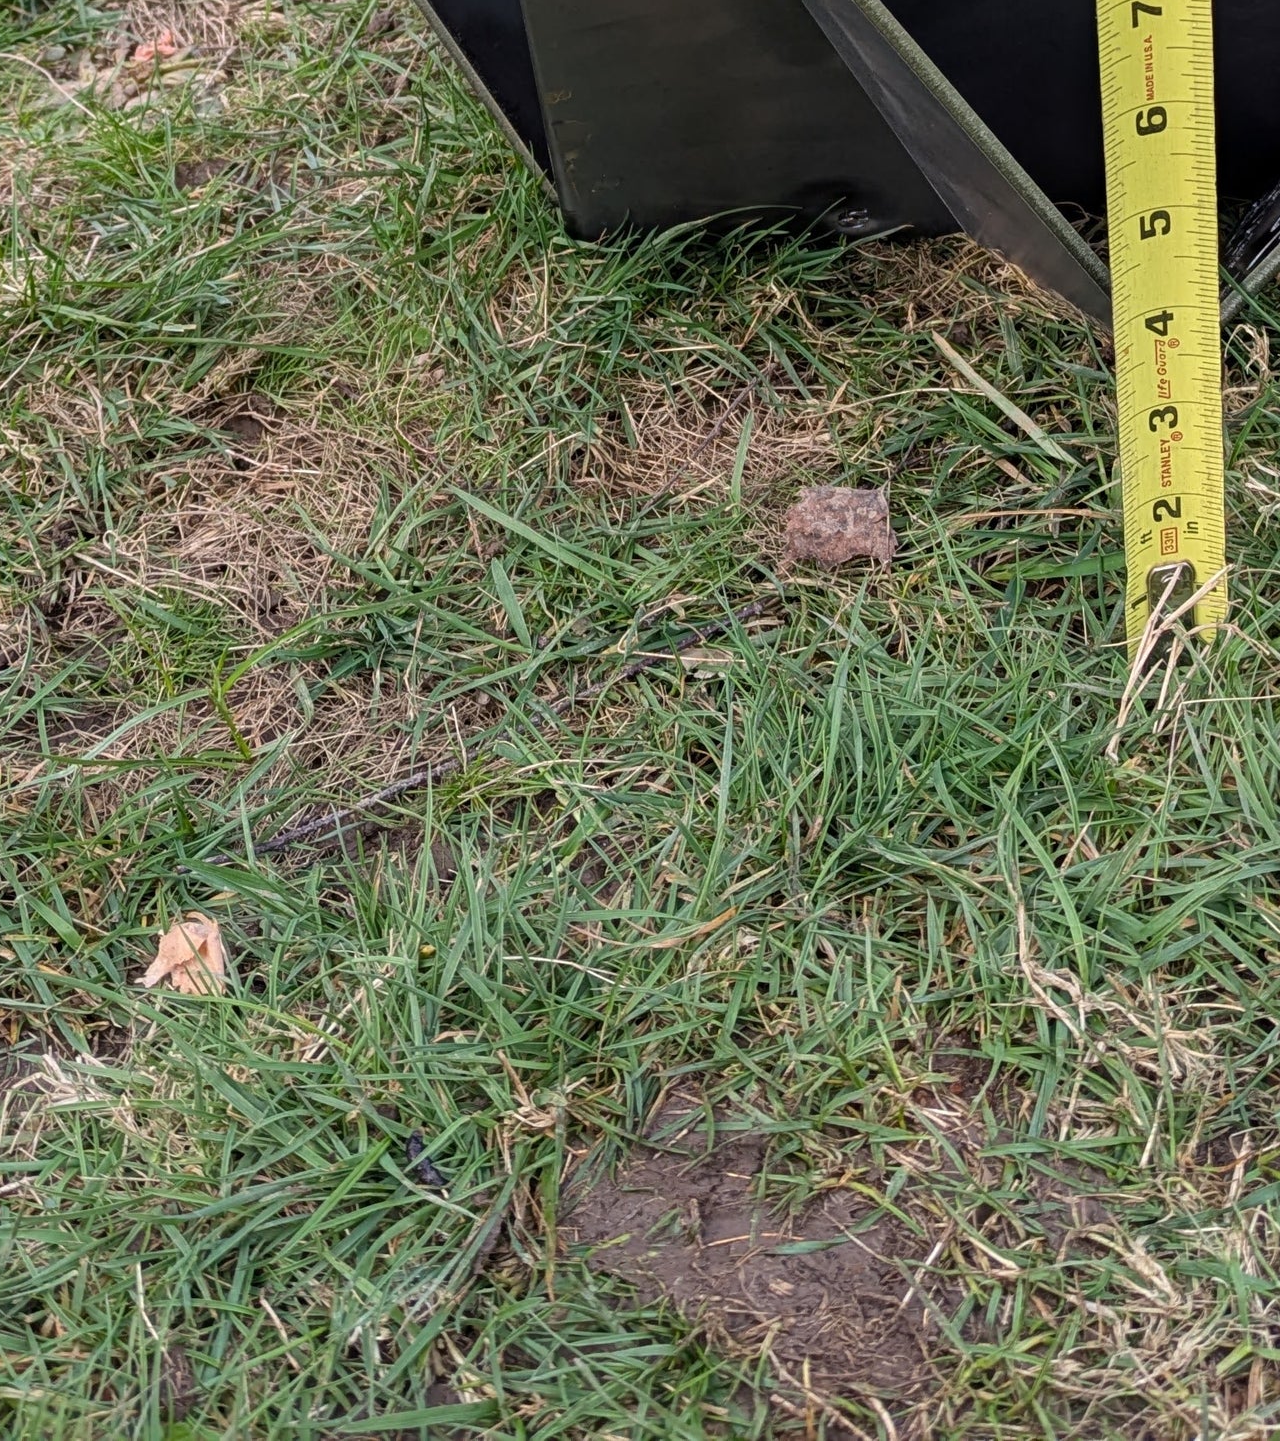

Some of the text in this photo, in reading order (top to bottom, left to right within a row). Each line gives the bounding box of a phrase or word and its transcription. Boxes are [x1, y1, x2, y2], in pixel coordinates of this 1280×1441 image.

[1131, 1, 1162, 28] 7
[1144, 62, 1154, 73] IN
[1145, 74, 1155, 101] MADE
[1136, 106, 1167, 136] 6
[1139, 210, 1171, 240] 5
[1145, 310, 1174, 336] 4
[1148, 405, 1178, 432] 3
[1160, 439, 1172, 488] STANLEY
[1152, 496, 1181, 522] 2
[1140, 529, 1152, 545] ft
[1183, 521, 1199, 534] in
[1130, 594, 1147, 610] 1
